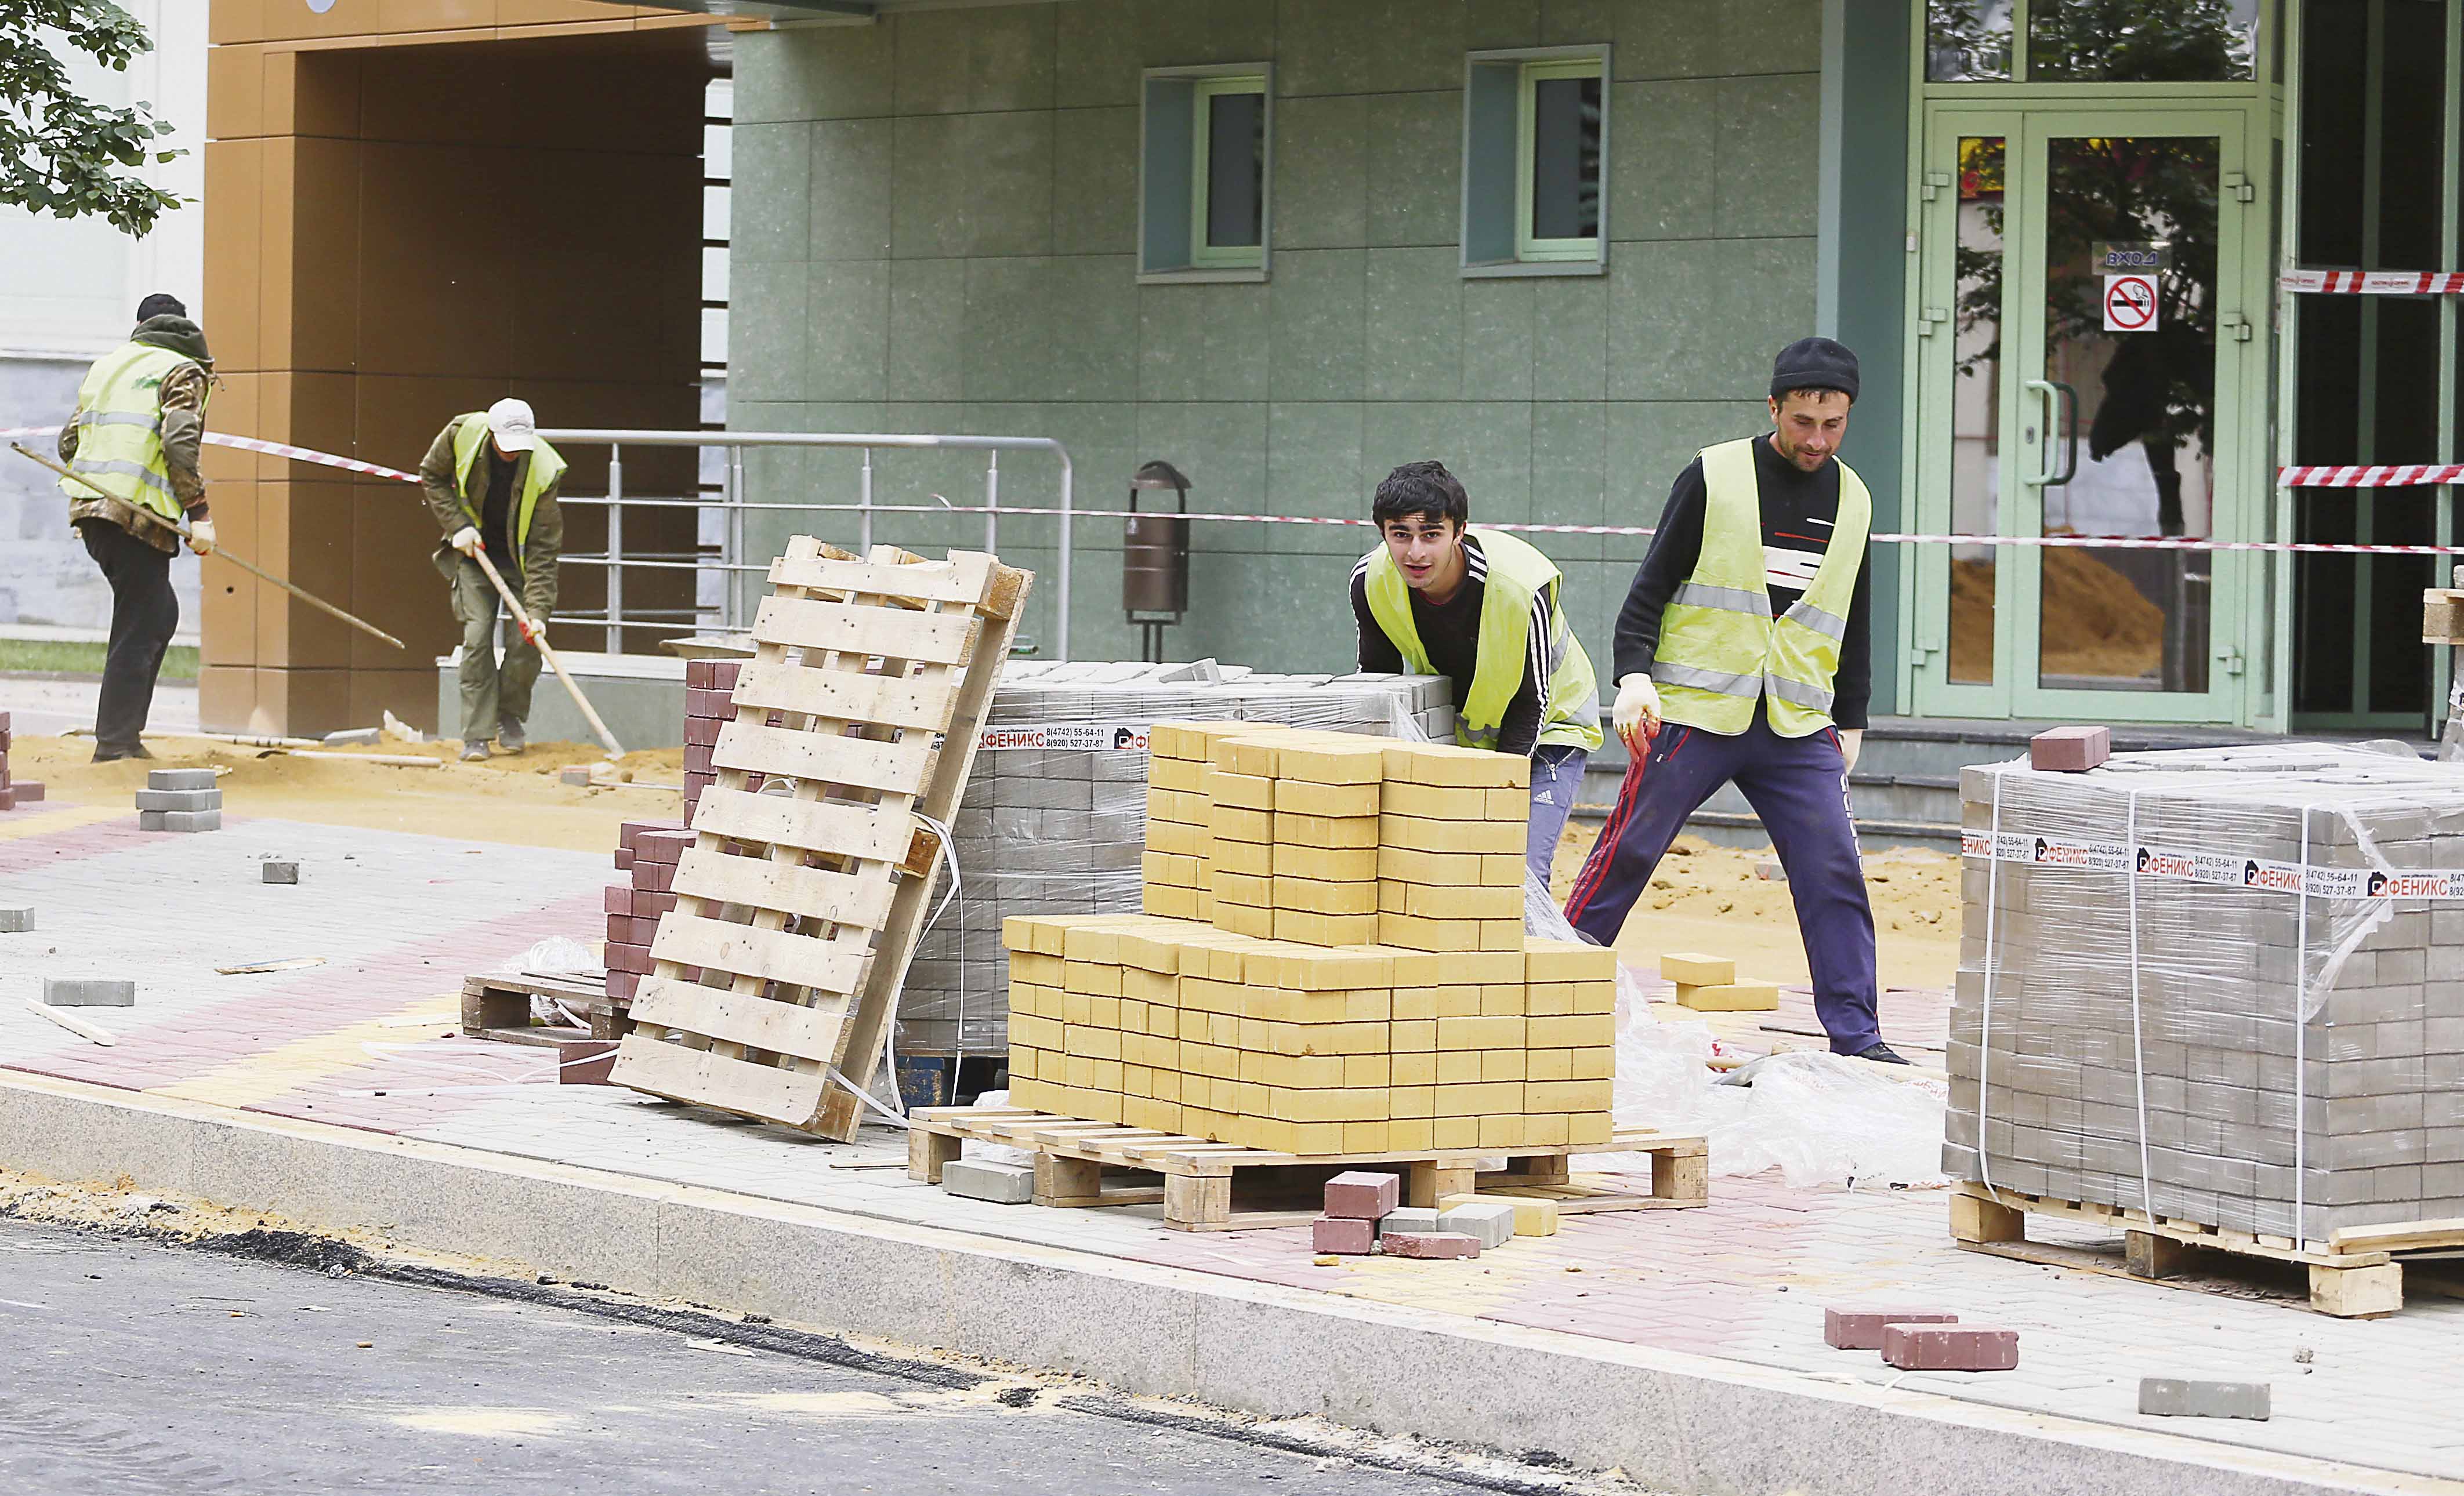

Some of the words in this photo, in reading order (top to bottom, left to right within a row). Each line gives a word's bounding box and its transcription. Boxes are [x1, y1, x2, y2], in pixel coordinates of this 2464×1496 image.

[1046, 728, 1072, 738] 8(4742)
[1074, 728, 1104, 737] 55-64-11
[986, 733, 1045, 747] ФЕНИКС
[1046, 739, 1068, 749] 8(920)
[1070, 739, 1104, 747] 527-37-87
[2009, 837, 2028, 847] 55-64-11
[2007, 848, 2029, 859] 527-37-87
[2049, 846, 2088, 865] ФЕНИКС
[2104, 858, 2129, 870] 527-37-87
[2151, 857, 2194, 877] ФЕНИКС
[2195, 855, 2214, 867] 8(4742)
[2215, 858, 2237, 869] 55-64-11
[2195, 869, 2211, 880] 8(920)
[2212, 870, 2237, 882] 527-37-87
[2327, 872, 2358, 883] 55-64-11
[2322, 886, 2356, 896] 527-37-87
[2389, 878, 2448, 896] ФЕНИКС
